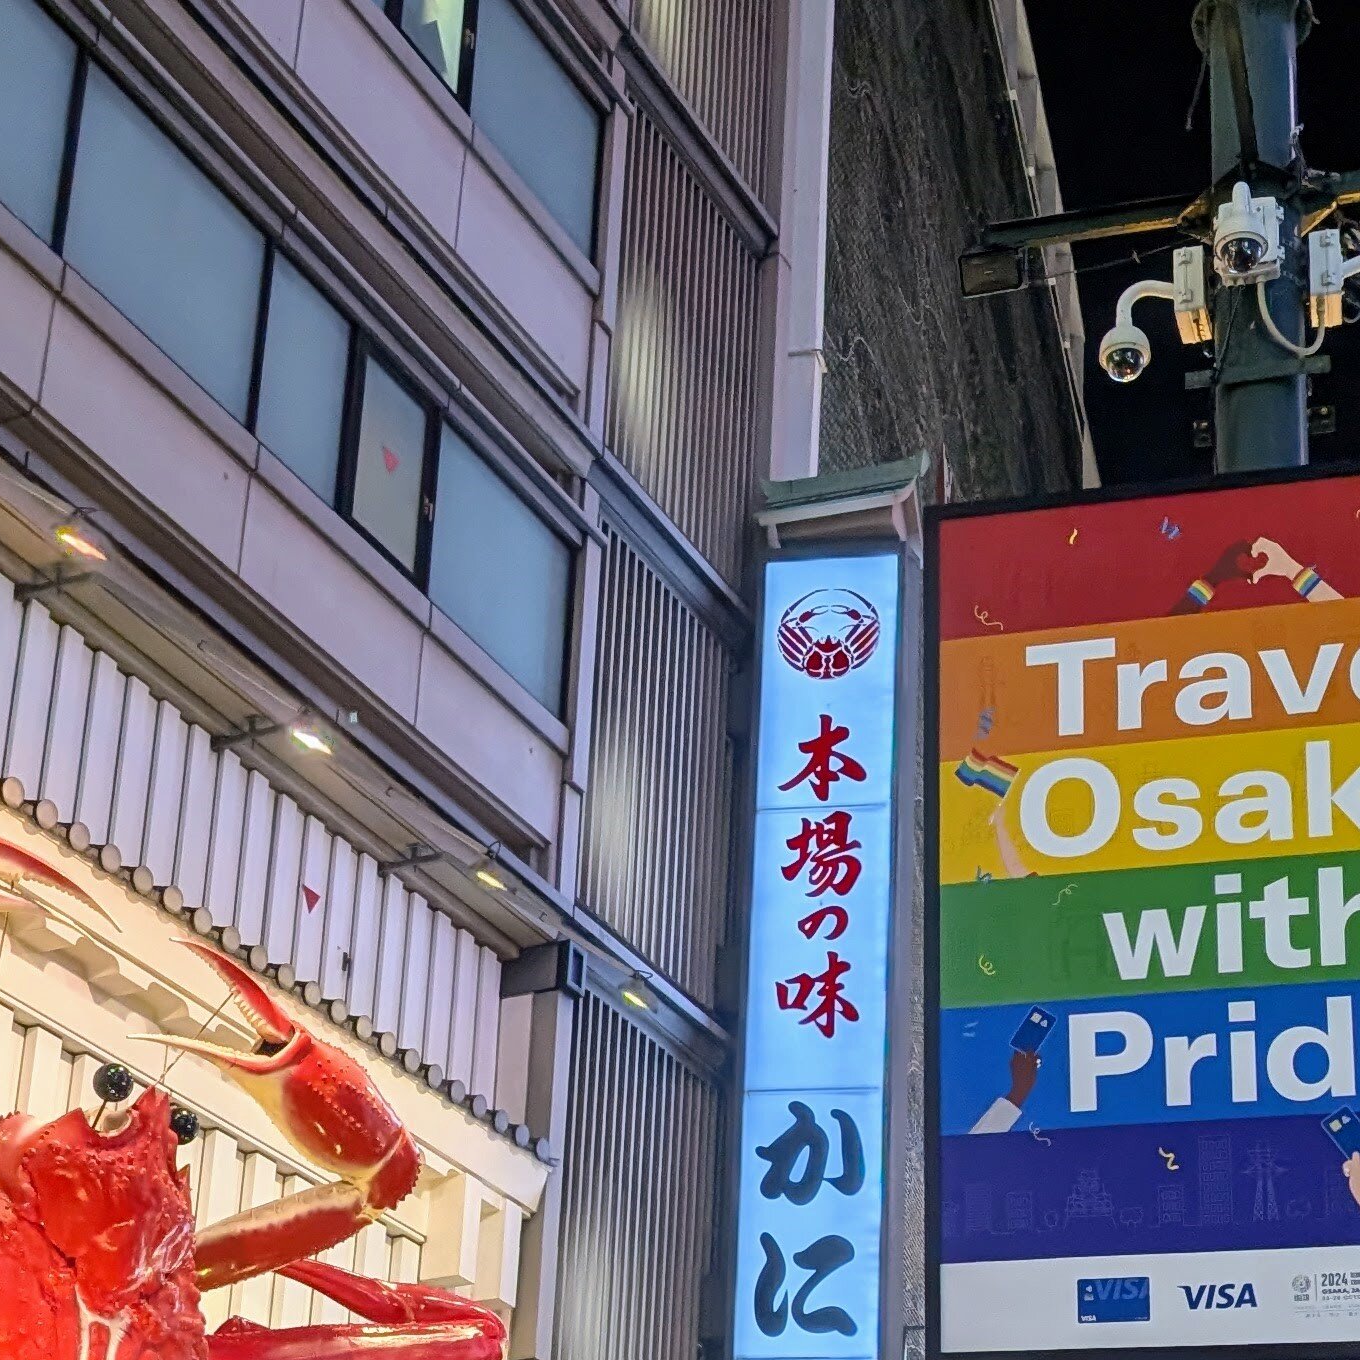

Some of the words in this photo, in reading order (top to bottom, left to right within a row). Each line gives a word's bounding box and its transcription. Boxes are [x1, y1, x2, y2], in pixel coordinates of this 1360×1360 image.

[776, 714, 866, 1038] 本場の味
[1321, 1272, 1348, 1286] 2024
[1177, 1283, 1258, 1309] VISA
